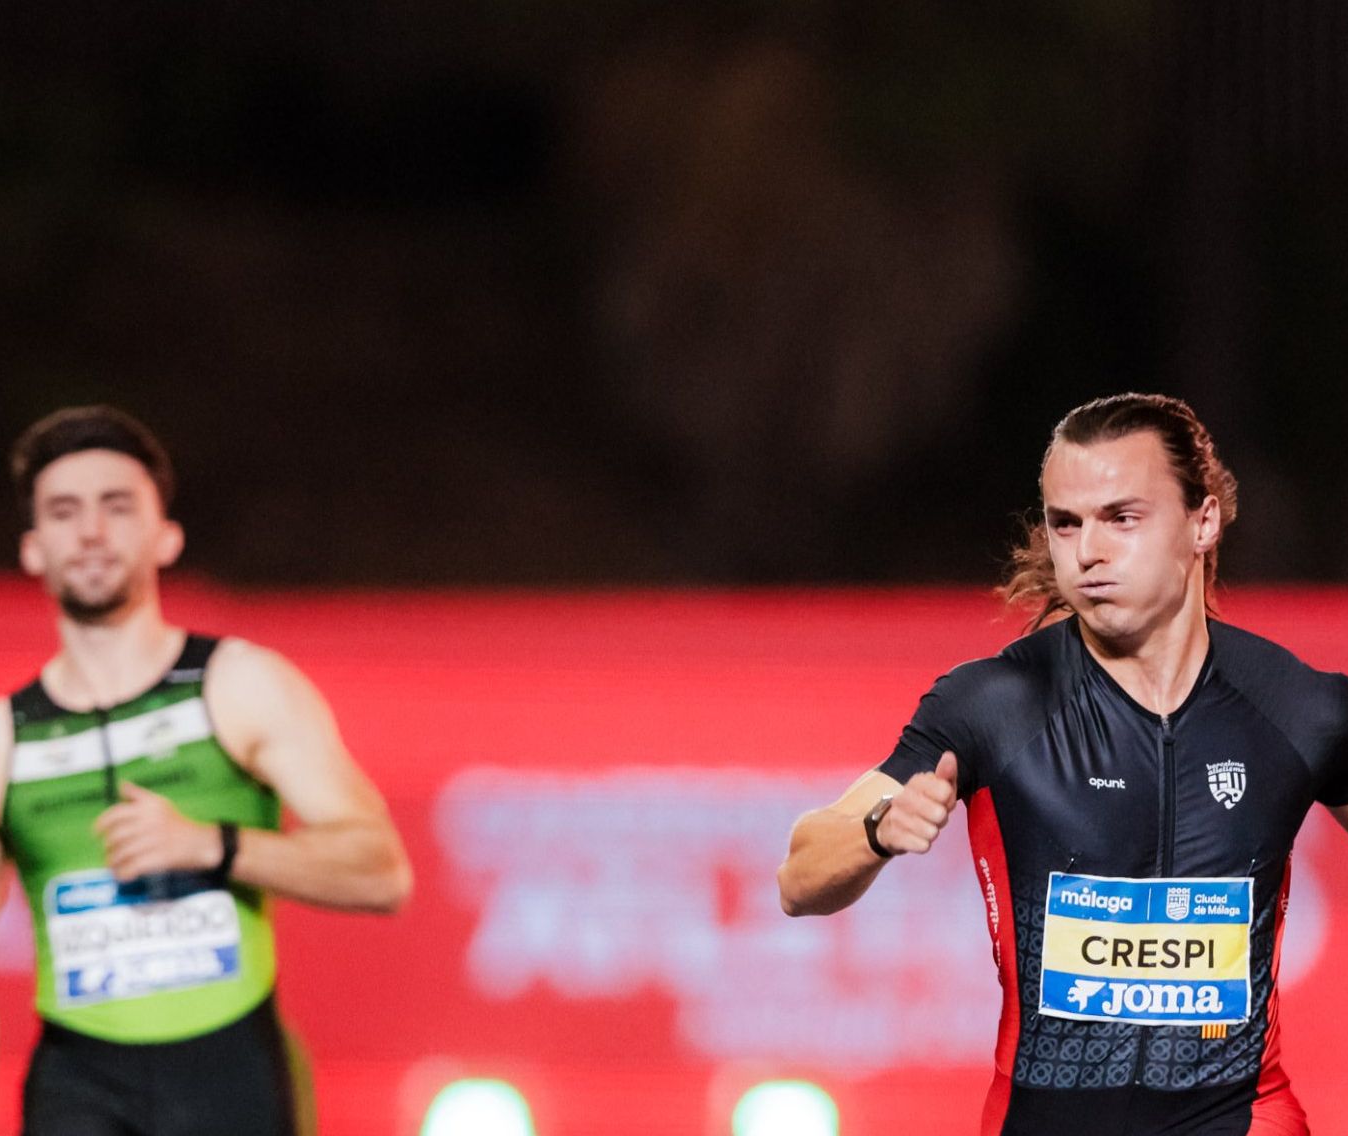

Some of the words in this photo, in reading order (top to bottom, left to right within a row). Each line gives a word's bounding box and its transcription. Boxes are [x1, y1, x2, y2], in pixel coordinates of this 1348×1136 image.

[1089, 777, 1126, 790] apunt
[1061, 887, 1133, 913] málaga
[1194, 894, 1228, 905] Ciudad
[1194, 905, 1207, 915] de
[1207, 905, 1240, 917] Málaga
[1081, 935, 1215, 969] CRESPI
